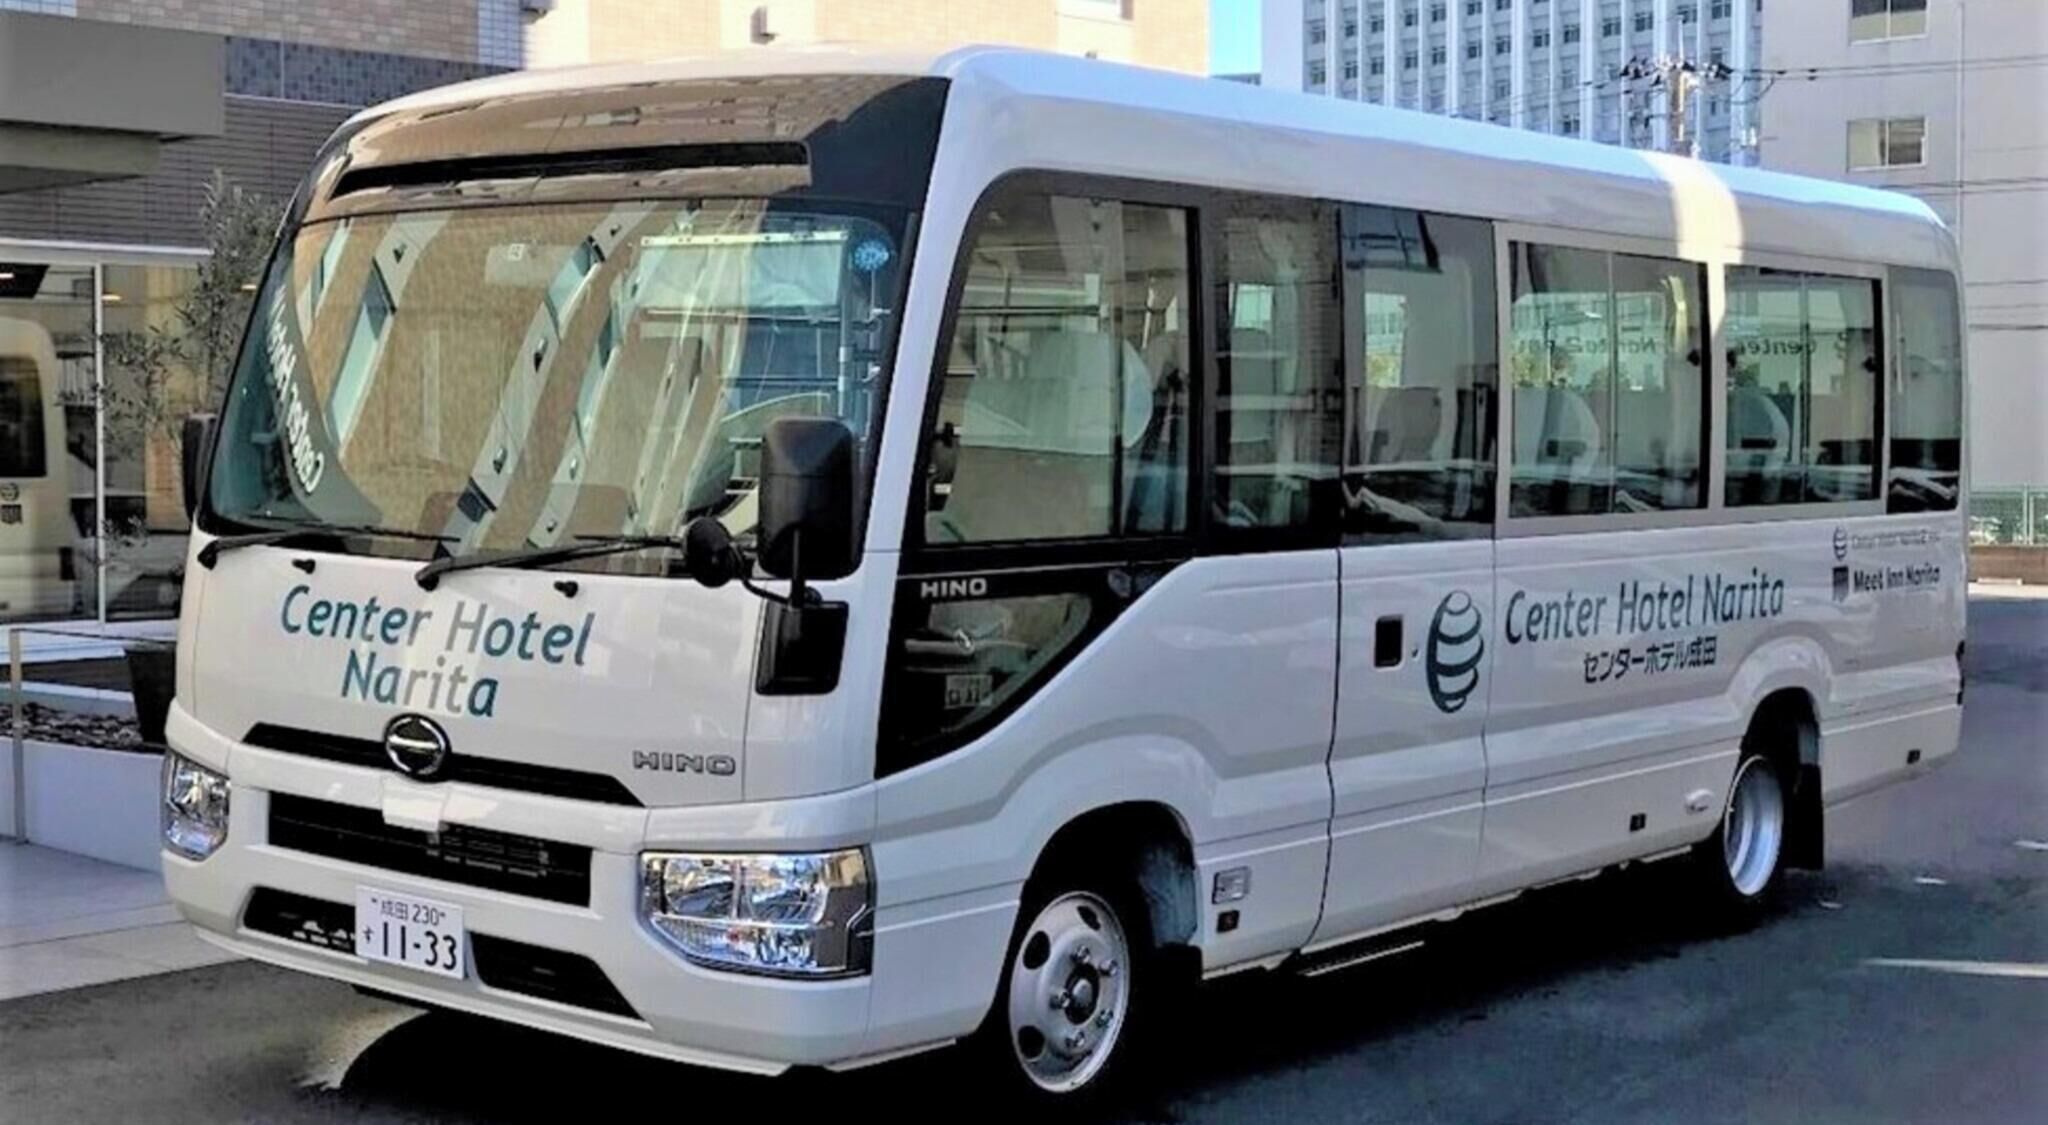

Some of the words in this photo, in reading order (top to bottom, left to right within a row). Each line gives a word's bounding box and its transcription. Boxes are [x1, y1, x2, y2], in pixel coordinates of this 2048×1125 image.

[920, 577, 988, 598] HINO
[1854, 569, 1883, 592] Meet
[281, 584, 432, 646] Center
[445, 601, 596, 666] Hotel
[1505, 590, 1607, 645] Center
[1617, 574, 1694, 634] Hotel
[1702, 567, 1785, 625] Narita
[340, 648, 499, 717] Narita
[1584, 636, 1718, 684] センターホテル成田
[632, 750, 736, 776] HINO
[412, 903, 439, 926] 230
[383, 921, 457, 970] 11-33
